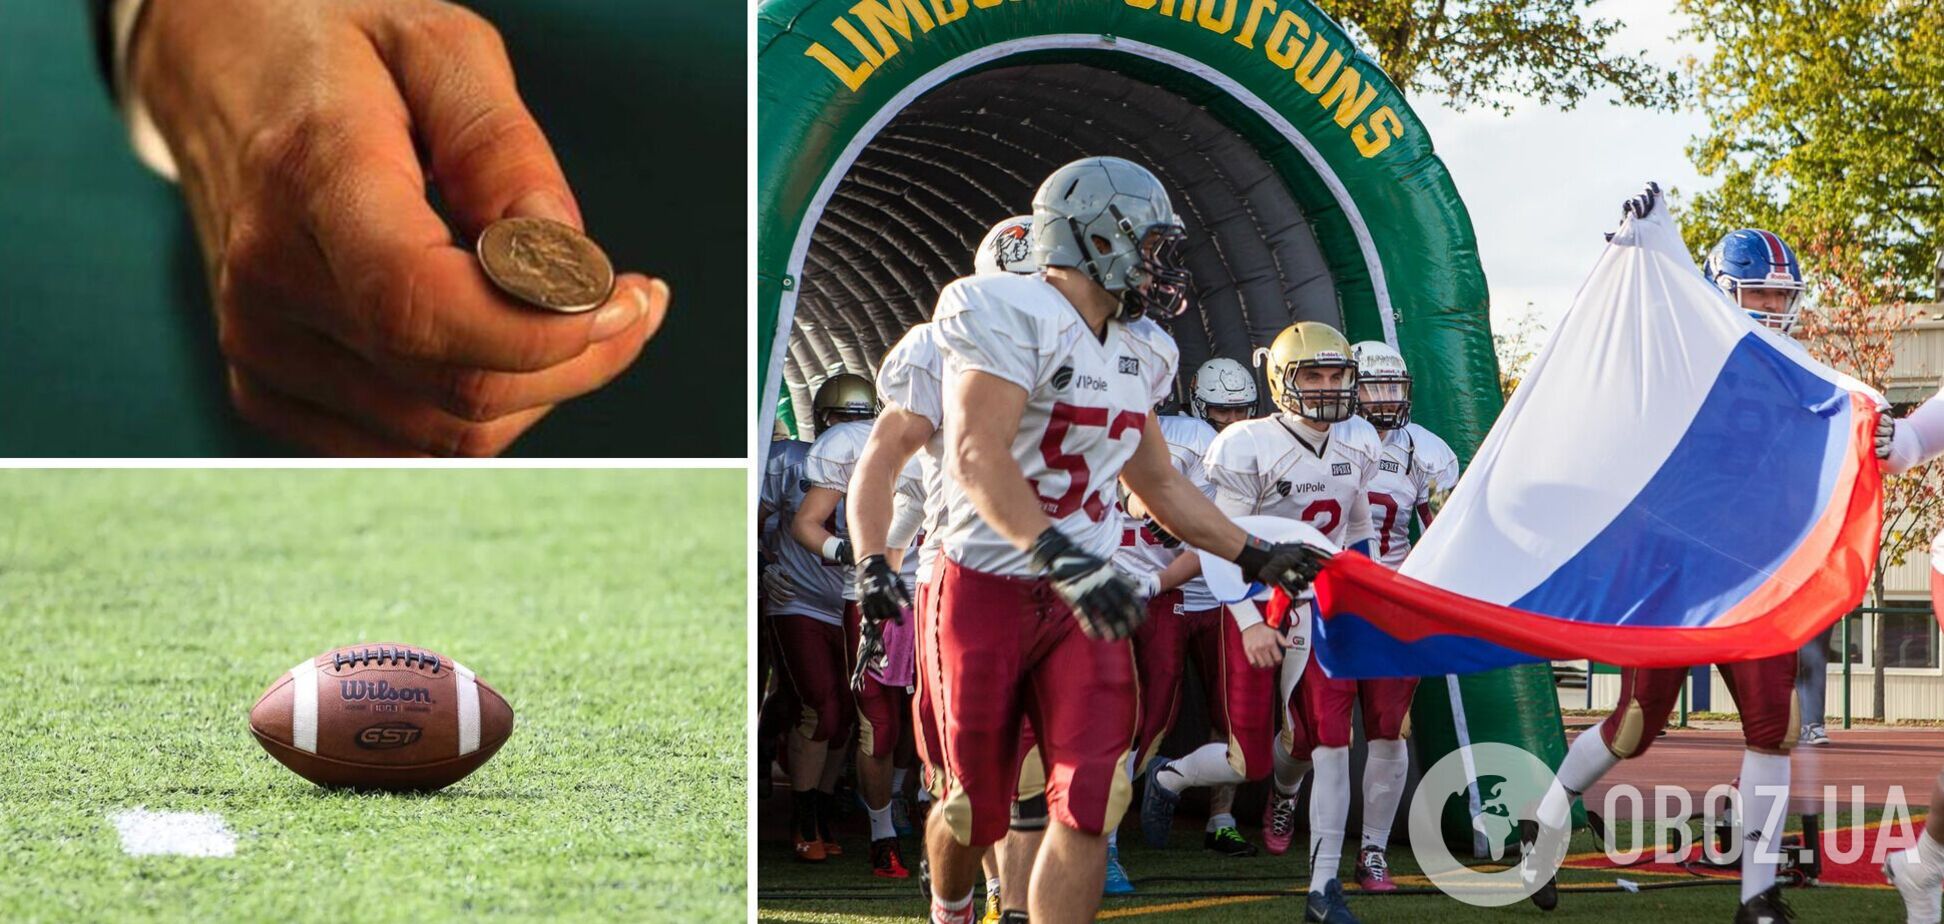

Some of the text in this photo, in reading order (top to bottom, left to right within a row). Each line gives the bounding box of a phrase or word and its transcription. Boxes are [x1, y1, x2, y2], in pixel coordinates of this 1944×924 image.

[1124, 0, 1404, 158] OTGUNS
[1296, 482, 1326, 494] VIPole
[341, 680, 433, 704] Wilson
[360, 727, 420, 743] GST
